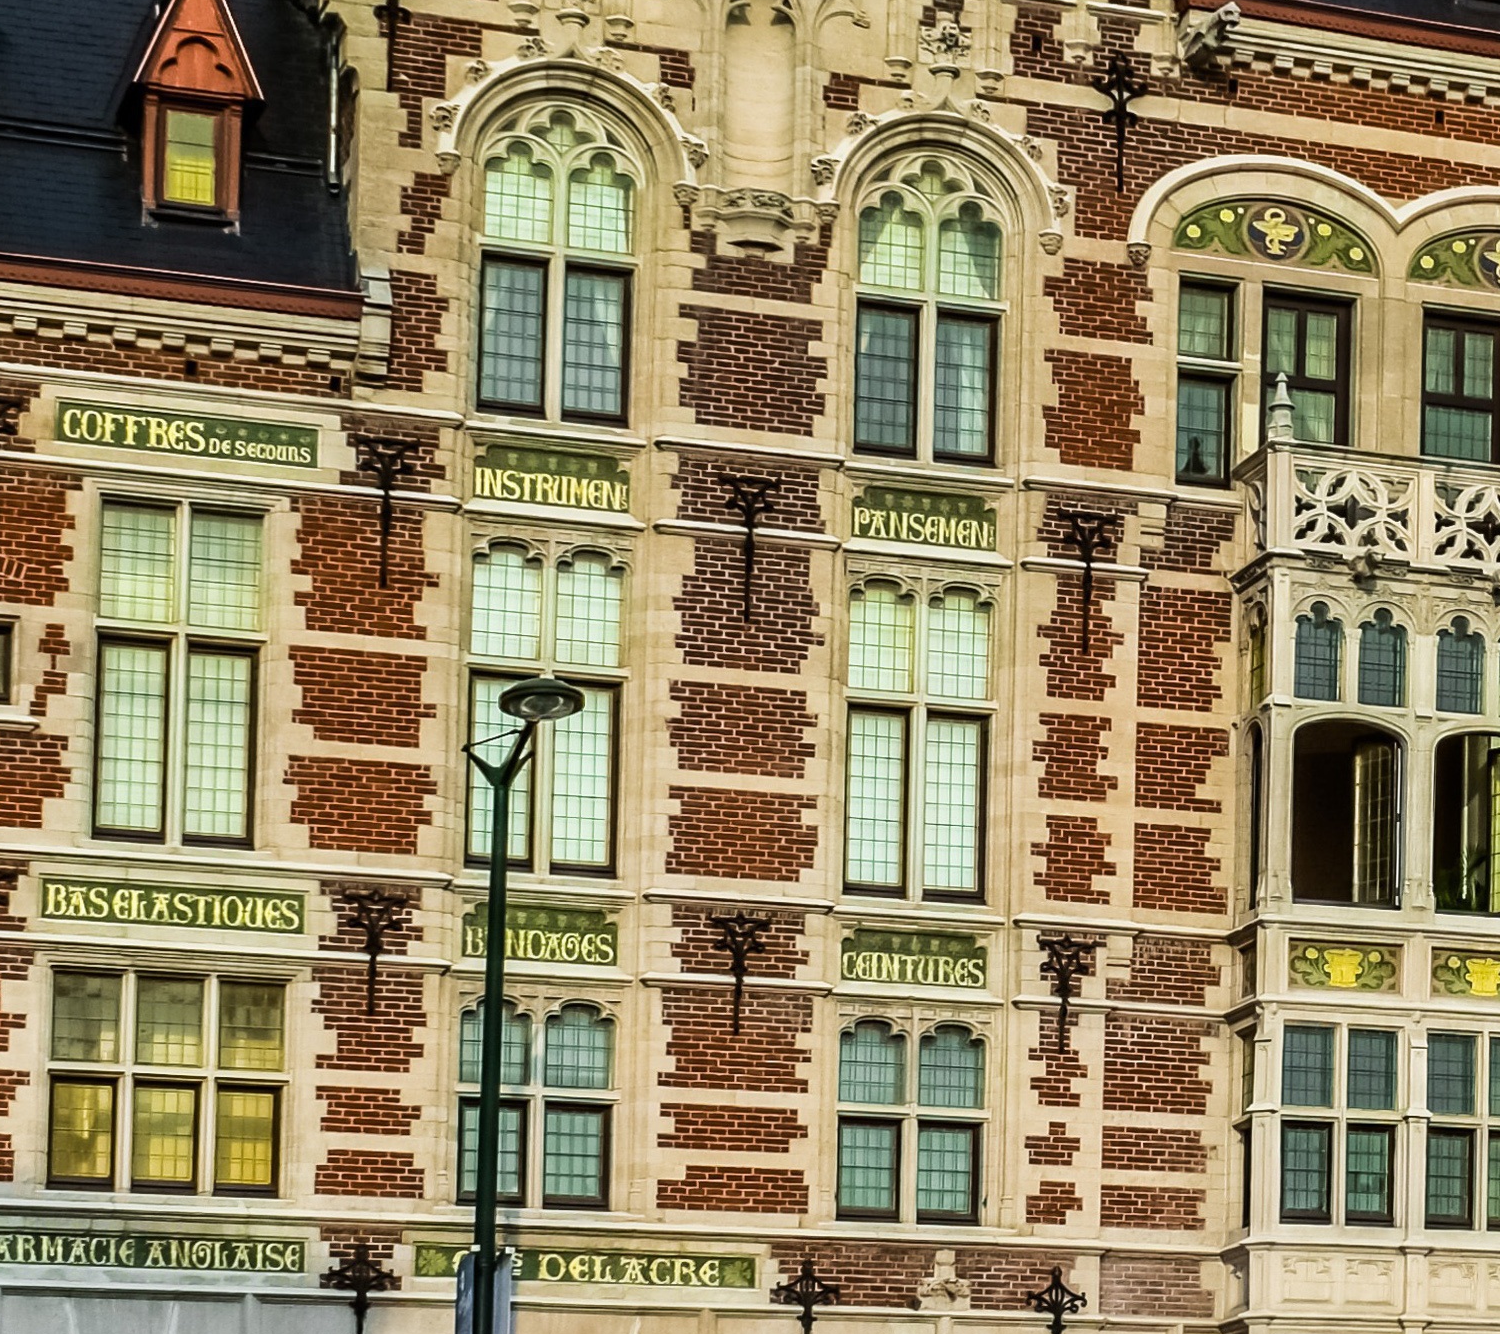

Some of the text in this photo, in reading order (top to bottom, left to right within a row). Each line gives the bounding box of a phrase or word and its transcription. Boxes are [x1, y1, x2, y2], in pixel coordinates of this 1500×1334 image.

[62, 408, 312, 464] COFFRES DE SECOURS
[44, 883, 109, 919] BAS
[464, 925, 615, 964] BNDAGES
[842, 951, 986, 987] CEINTURES
[143, 1239, 302, 1272] ANGLAISE
[538, 1252, 721, 1287] DELACRE
